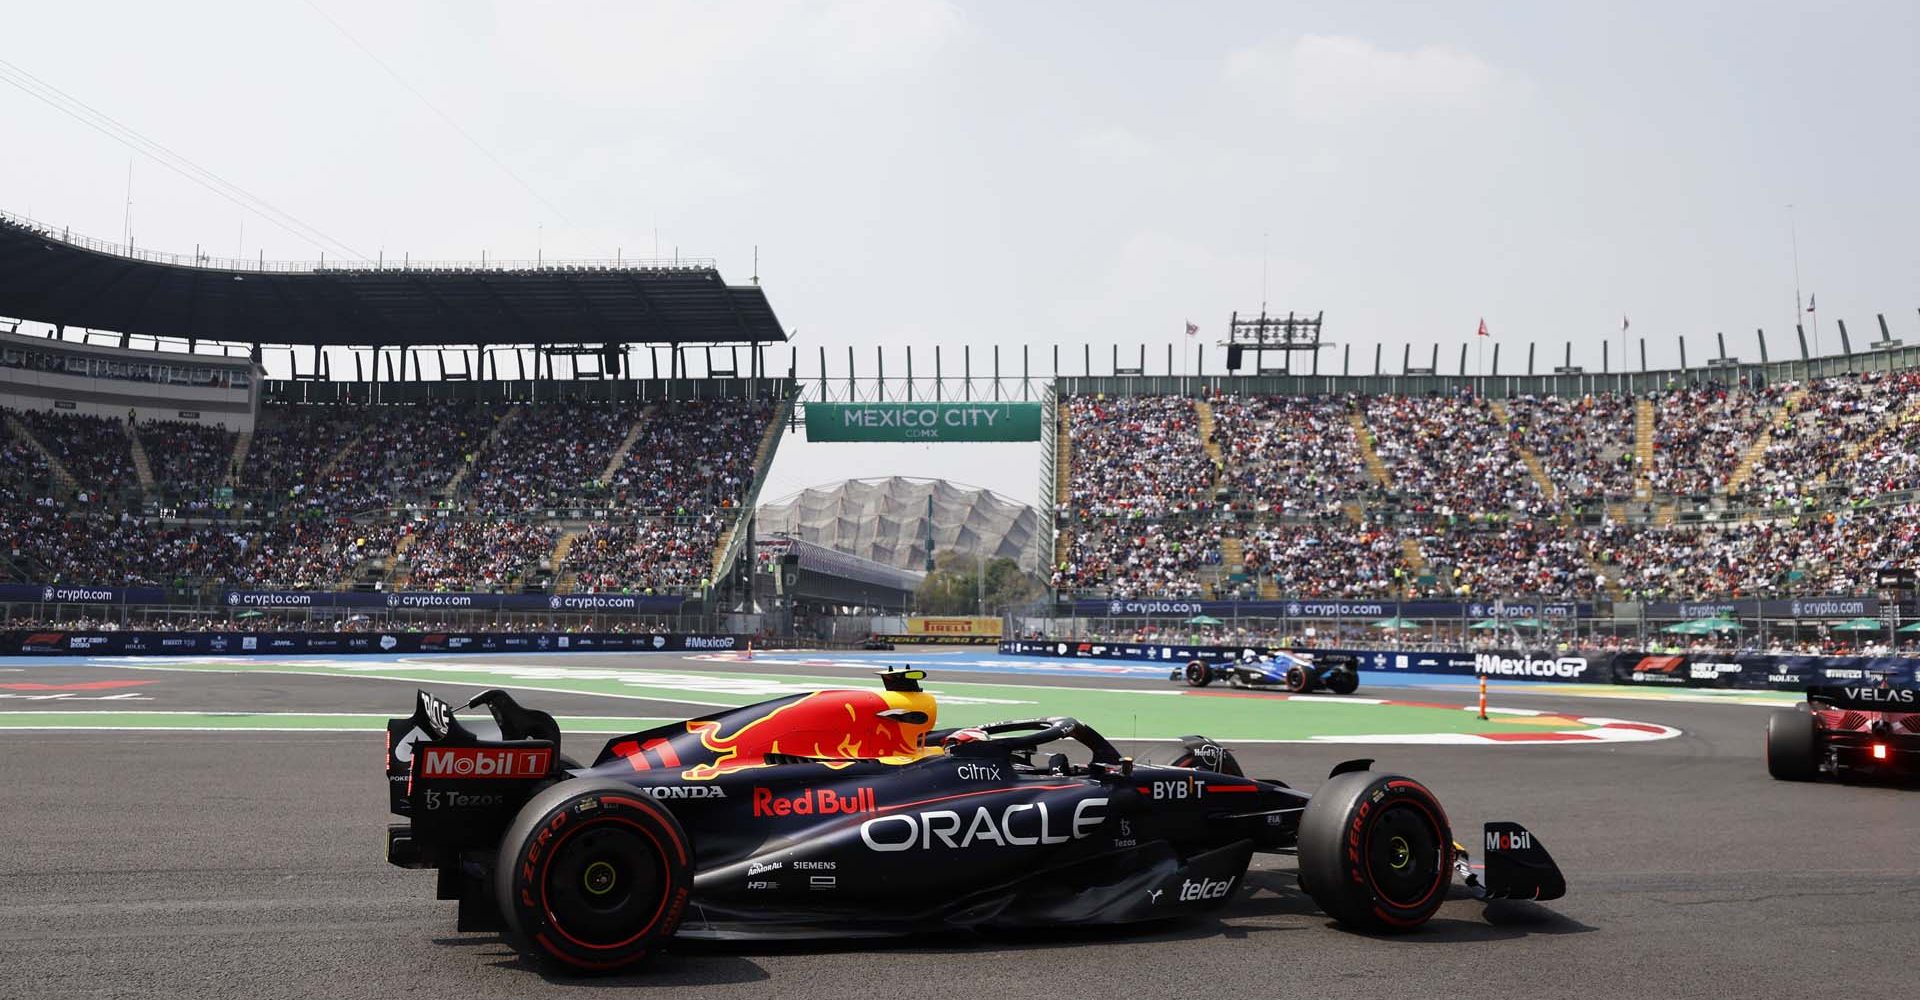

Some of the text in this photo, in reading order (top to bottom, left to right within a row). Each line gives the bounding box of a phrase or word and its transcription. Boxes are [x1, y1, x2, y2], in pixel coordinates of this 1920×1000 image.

[844, 409, 999, 427] MEXICO CITY
[905, 429, 939, 438] CDMX
[57, 588, 112, 601] crypto.com
[244, 593, 311, 605] crypto.com
[564, 597, 635, 609] crypto.com
[1126, 602, 1202, 614] crypto.com
[1304, 603, 1382, 616] crypto.com
[1804, 601, 1864, 615] crypto.com
[923, 620, 972, 632] PIRELLI
[685, 636, 735, 649] #MexicoGP
[1475, 654, 1587, 677] #MexicoGP
[1768, 674, 1800, 682] ROLEX
[1844, 687, 1914, 703] VELAS
[612, 738, 681, 772] 11
[424, 750, 538, 775] Mobil 1
[957, 763, 1002, 781] citrix
[1152, 775, 1205, 800] BYBIT
[753, 787, 876, 816] Red Bull
[859, 797, 1109, 852] ORACLE
[1114, 838, 1137, 847] Tezos
[1485, 831, 1531, 850] Mobil
[793, 861, 836, 870] SIEMENS
[1179, 875, 1236, 901] telcel
